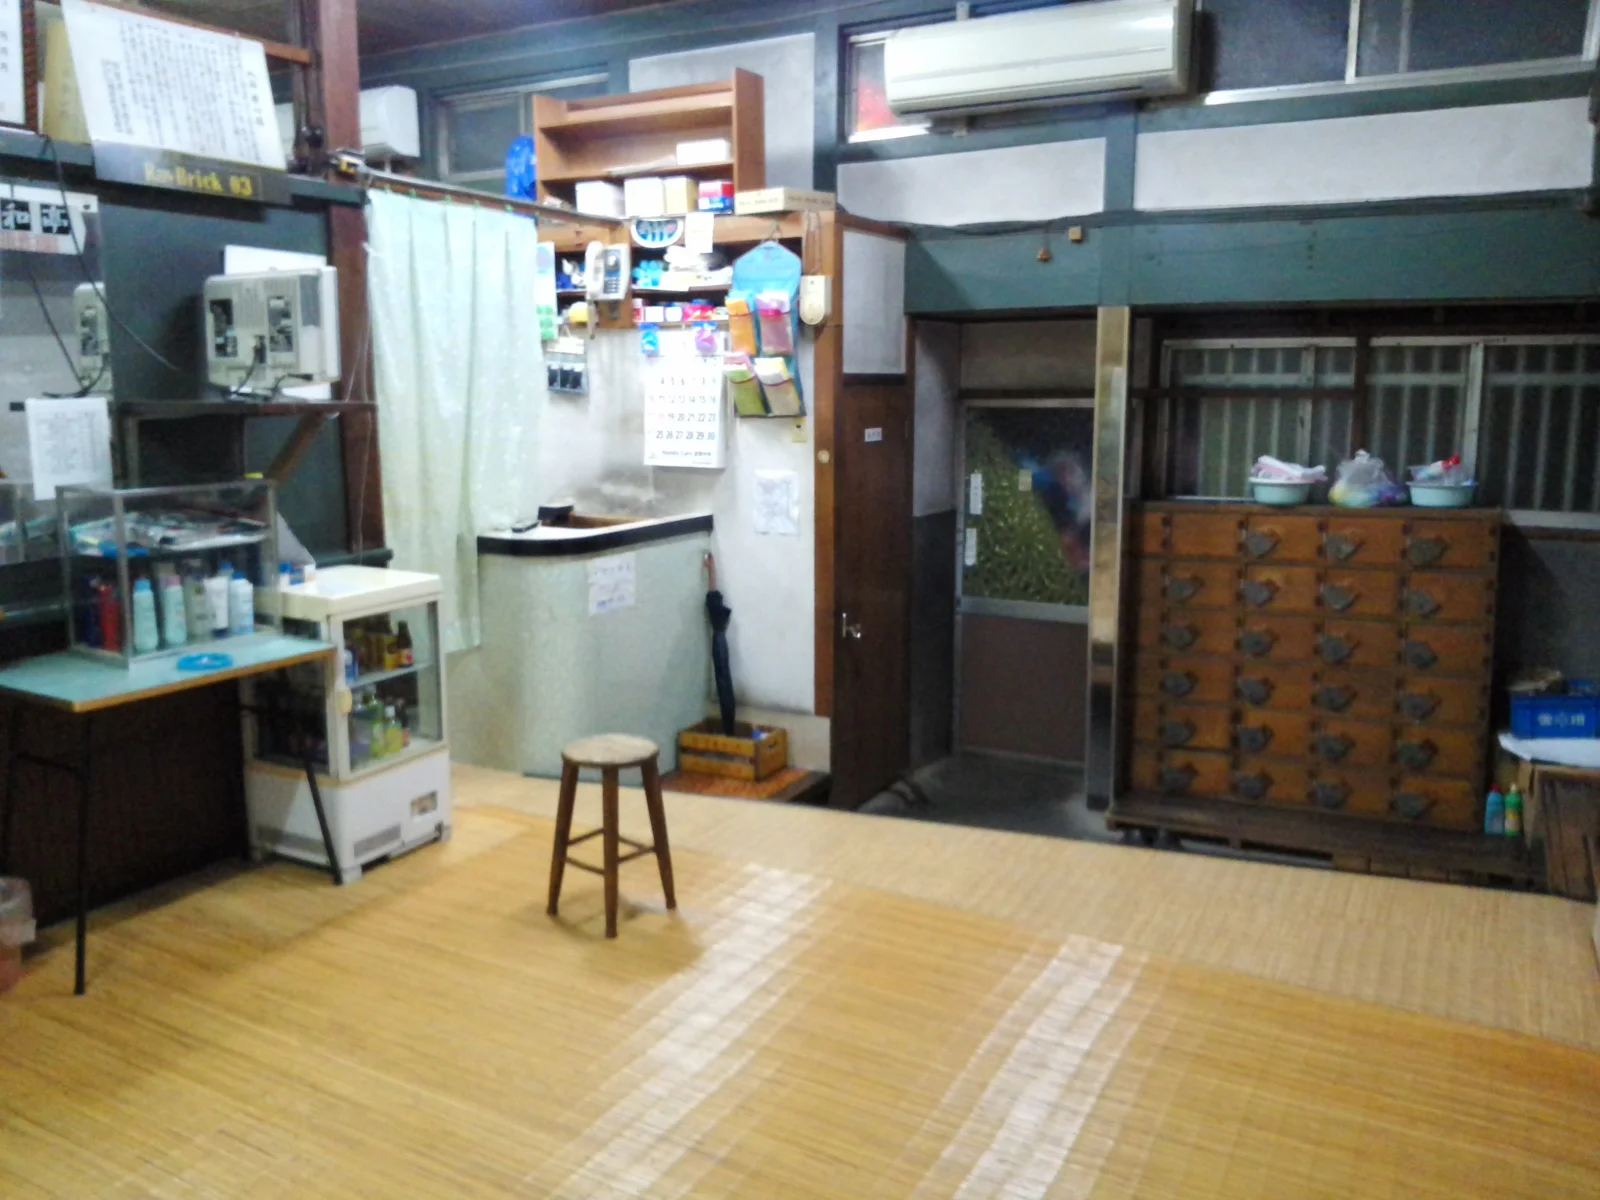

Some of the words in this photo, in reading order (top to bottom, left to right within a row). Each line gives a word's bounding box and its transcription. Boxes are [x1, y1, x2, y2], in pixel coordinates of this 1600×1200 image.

[677, 412, 686, 423] 20
[687, 412, 695, 423] 21
[697, 412, 706, 423] 22
[707, 412, 717, 423] 23
[656, 429, 664, 440] 25
[665, 430, 674, 440] 26
[675, 430, 684, 440] 27
[685, 431, 694, 441] 28
[696, 431, 705, 441] 29
[706, 431, 716, 441] 30
